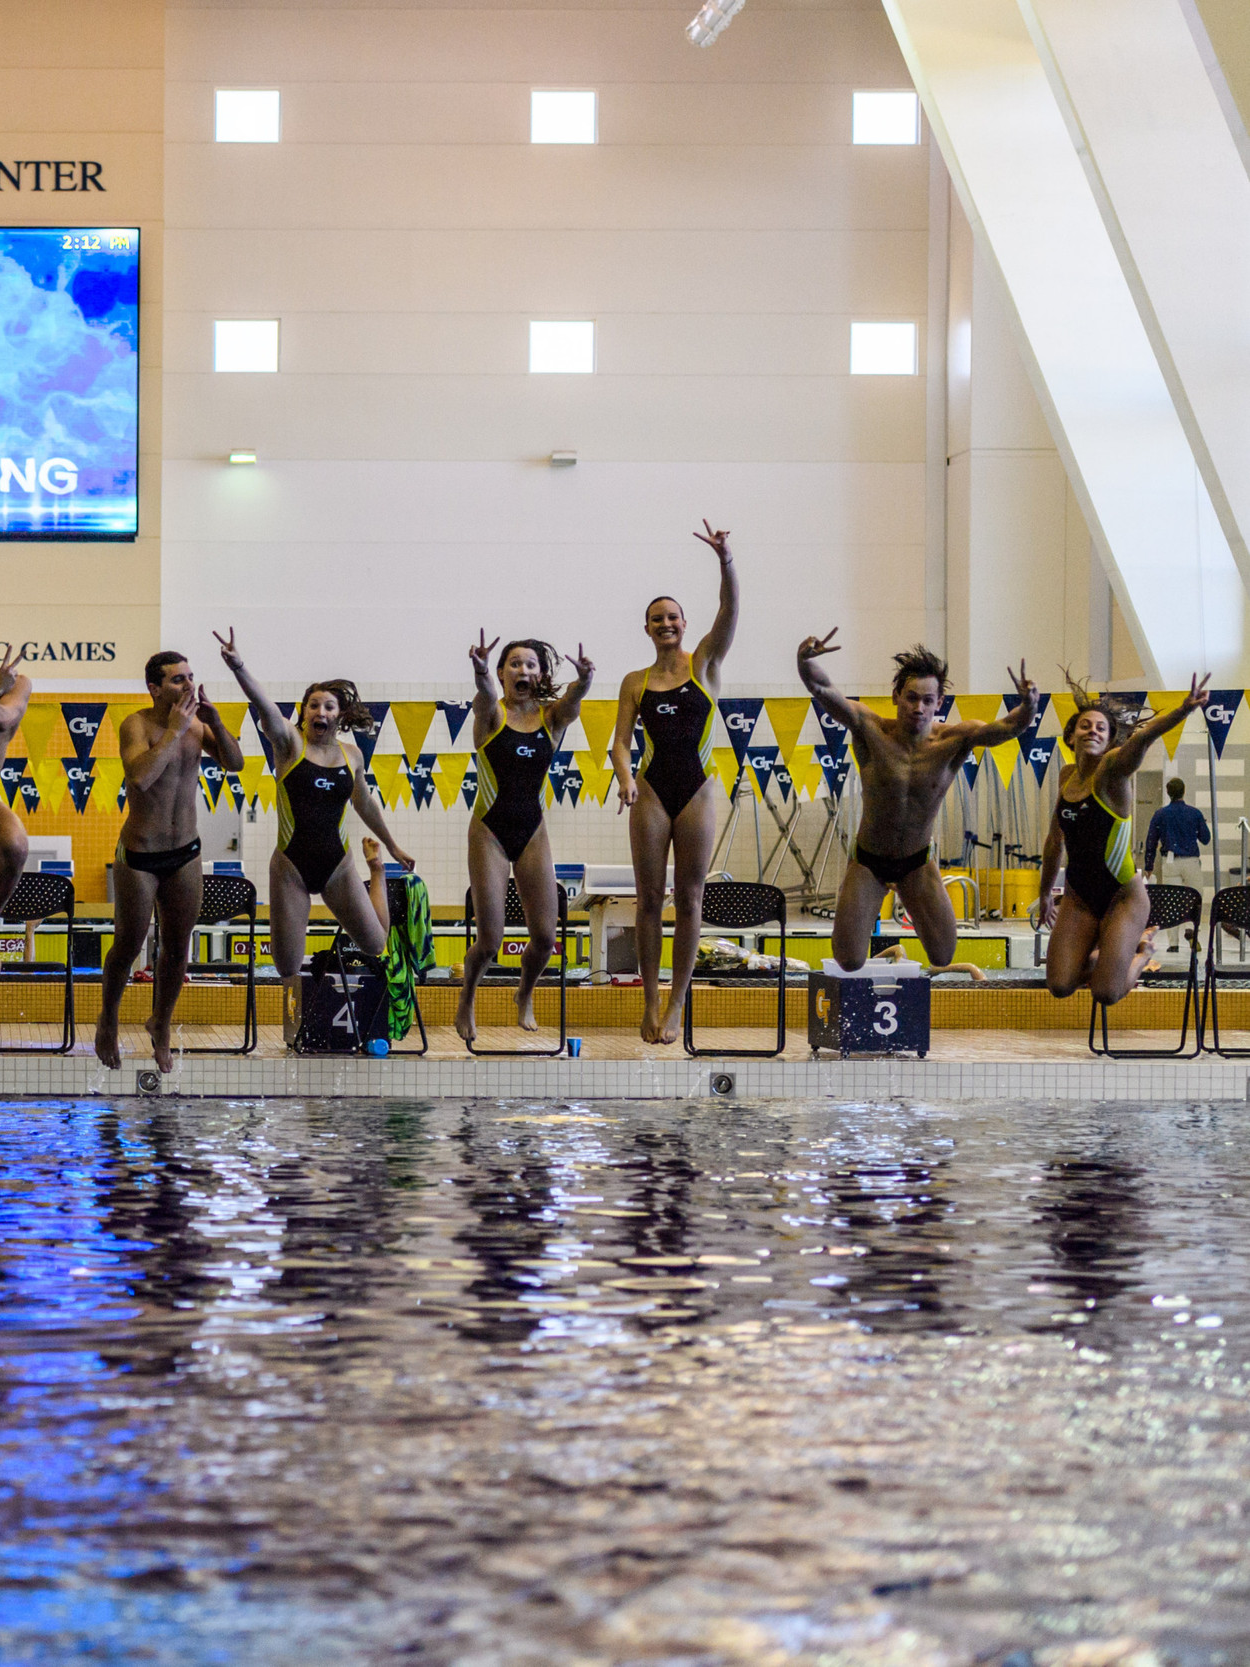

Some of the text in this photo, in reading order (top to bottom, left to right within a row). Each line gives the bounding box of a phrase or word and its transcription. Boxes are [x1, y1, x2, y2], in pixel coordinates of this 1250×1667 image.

[62, 235, 129, 249] 2:12 PM
[21, 641, 116, 661] GAMES
[332, 1001, 359, 1034] 4
[872, 1001, 898, 1035] 3
